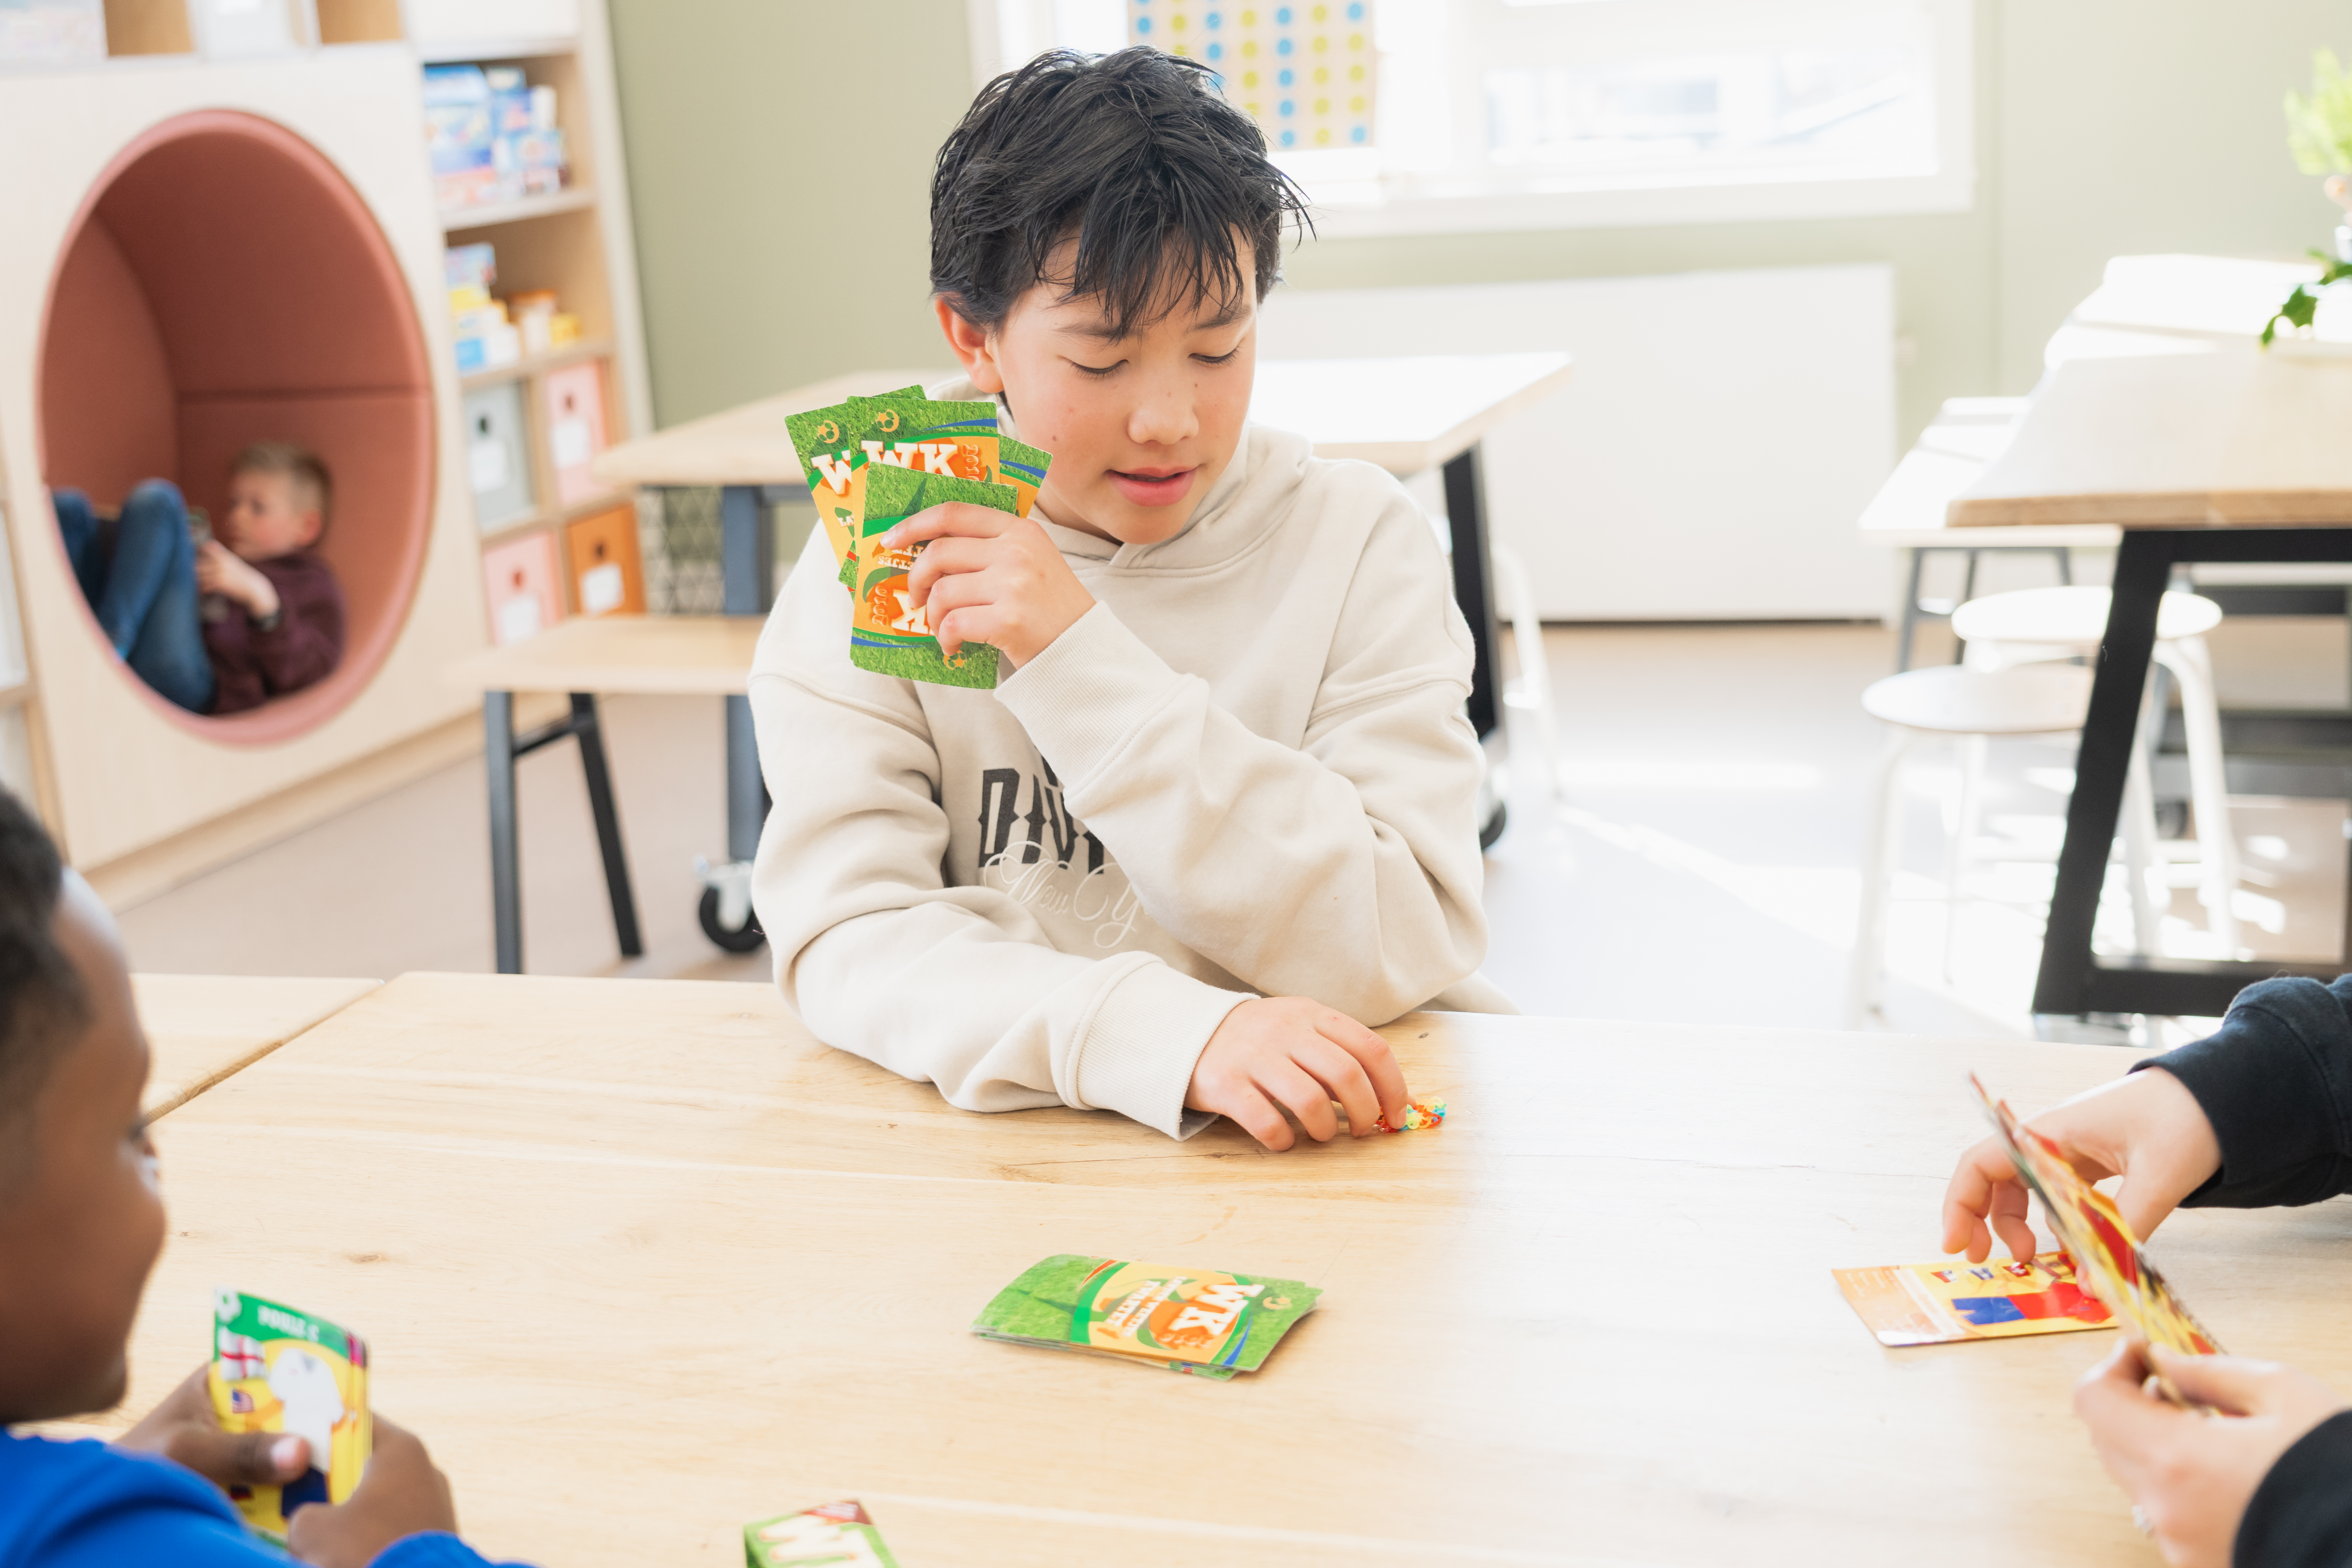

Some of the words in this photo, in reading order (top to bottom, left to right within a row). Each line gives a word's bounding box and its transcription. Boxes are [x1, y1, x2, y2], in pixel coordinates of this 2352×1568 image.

[877, 555, 913, 570] ETJES
[872, 585, 889, 626] 2010
[891, 589, 935, 635] K
[257, 1305, 306, 1338] POULE
[1104, 1280, 1161, 1327] KWARTET
[1167, 1283, 1266, 1336] WK
